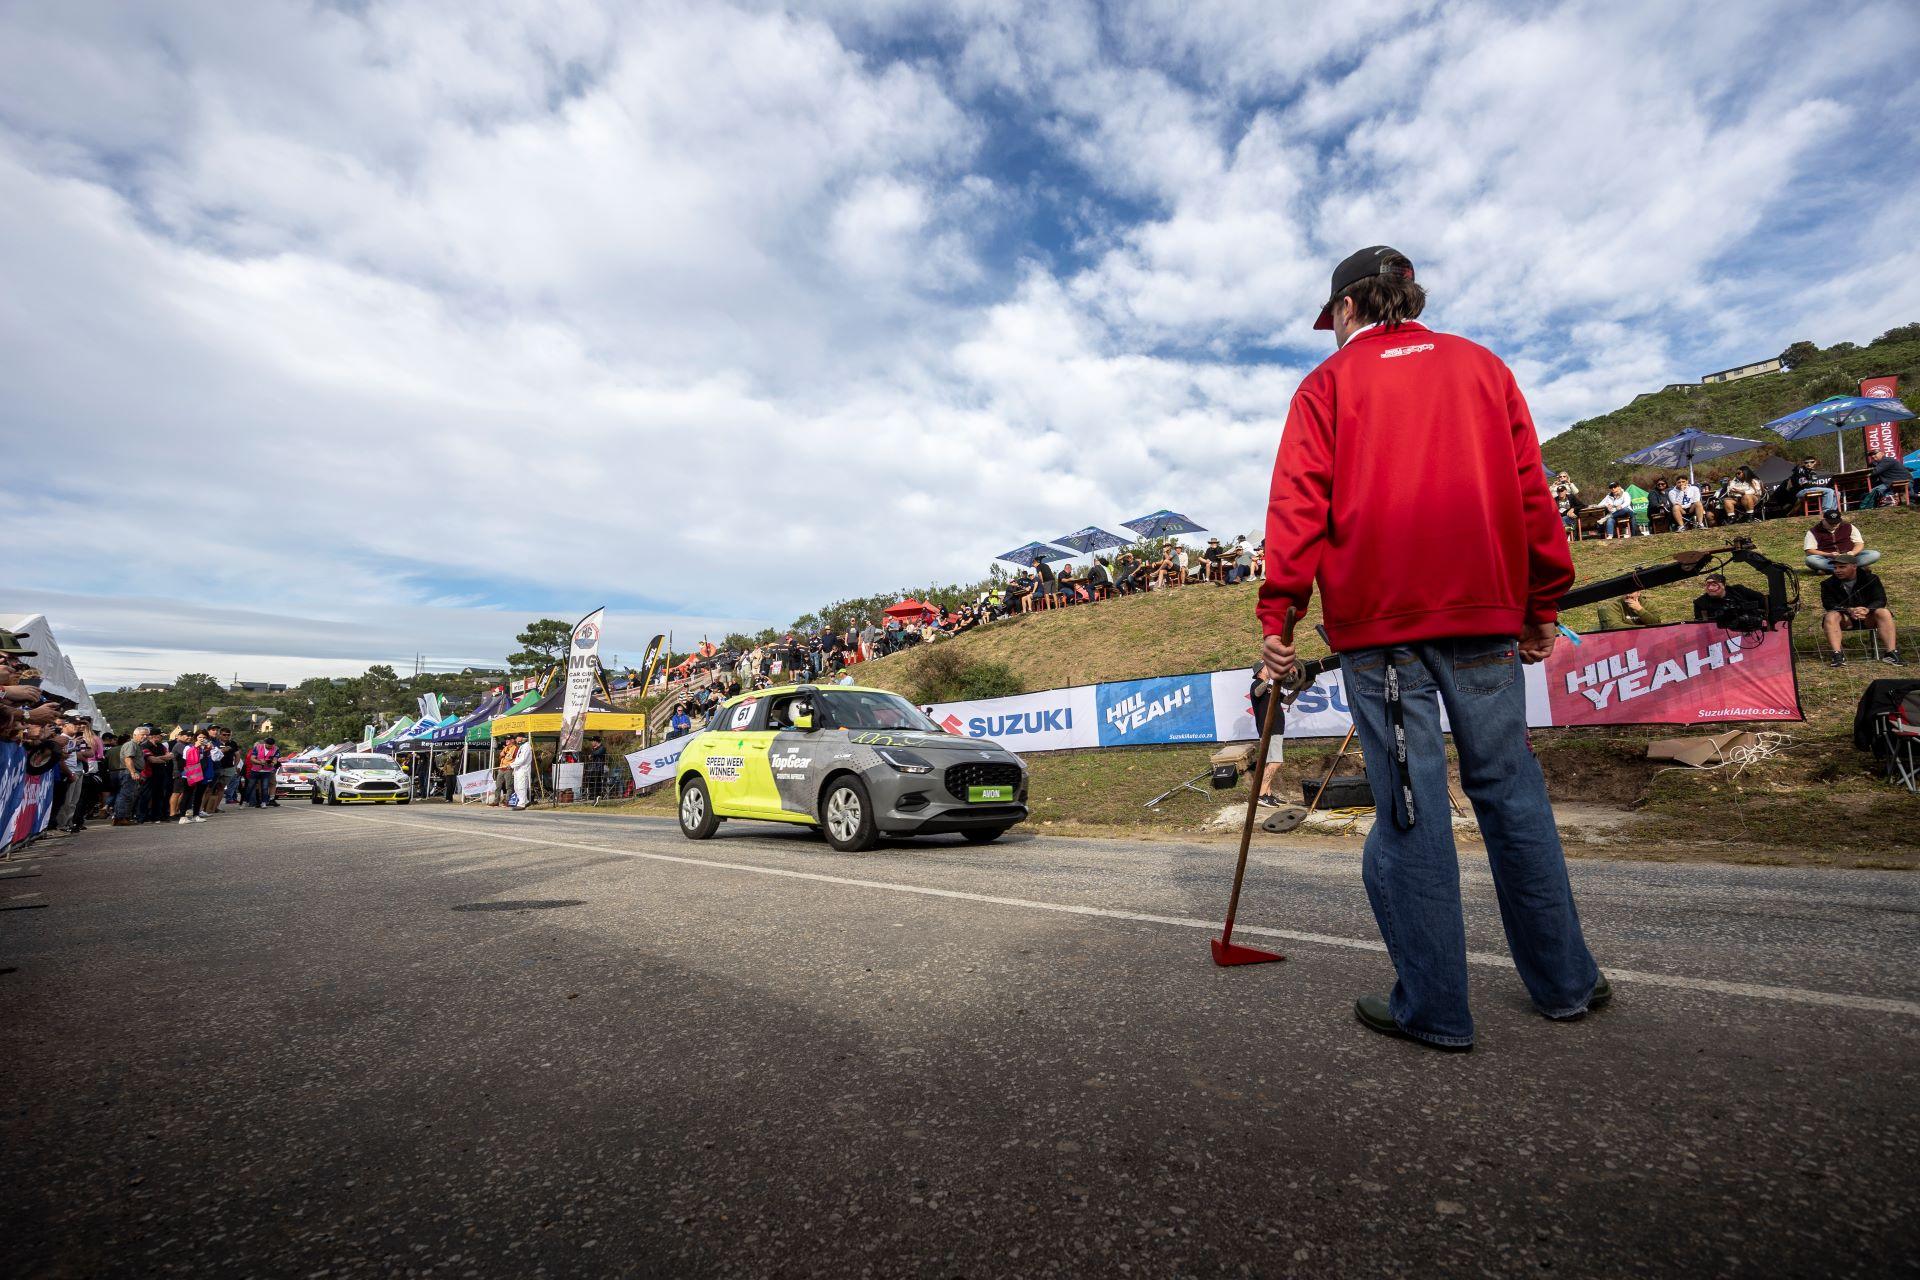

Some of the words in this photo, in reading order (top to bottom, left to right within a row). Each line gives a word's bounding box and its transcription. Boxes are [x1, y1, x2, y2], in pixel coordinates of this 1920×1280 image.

[569, 654, 597, 669] MG
[1565, 647, 1647, 694] HILL
[1581, 635, 1744, 711] YEAH!
[737, 706, 751, 721] 61
[1105, 690, 1146, 724] HILL
[1113, 684, 1192, 735] YEAH!
[1698, 706, 1791, 718] SuzukiAuto.co.za
[968, 707, 1073, 738] SUZUKI
[706, 757, 726, 766] SPEED
[726, 758, 744, 766] WEEK
[982, 789, 1001, 798] AVON
